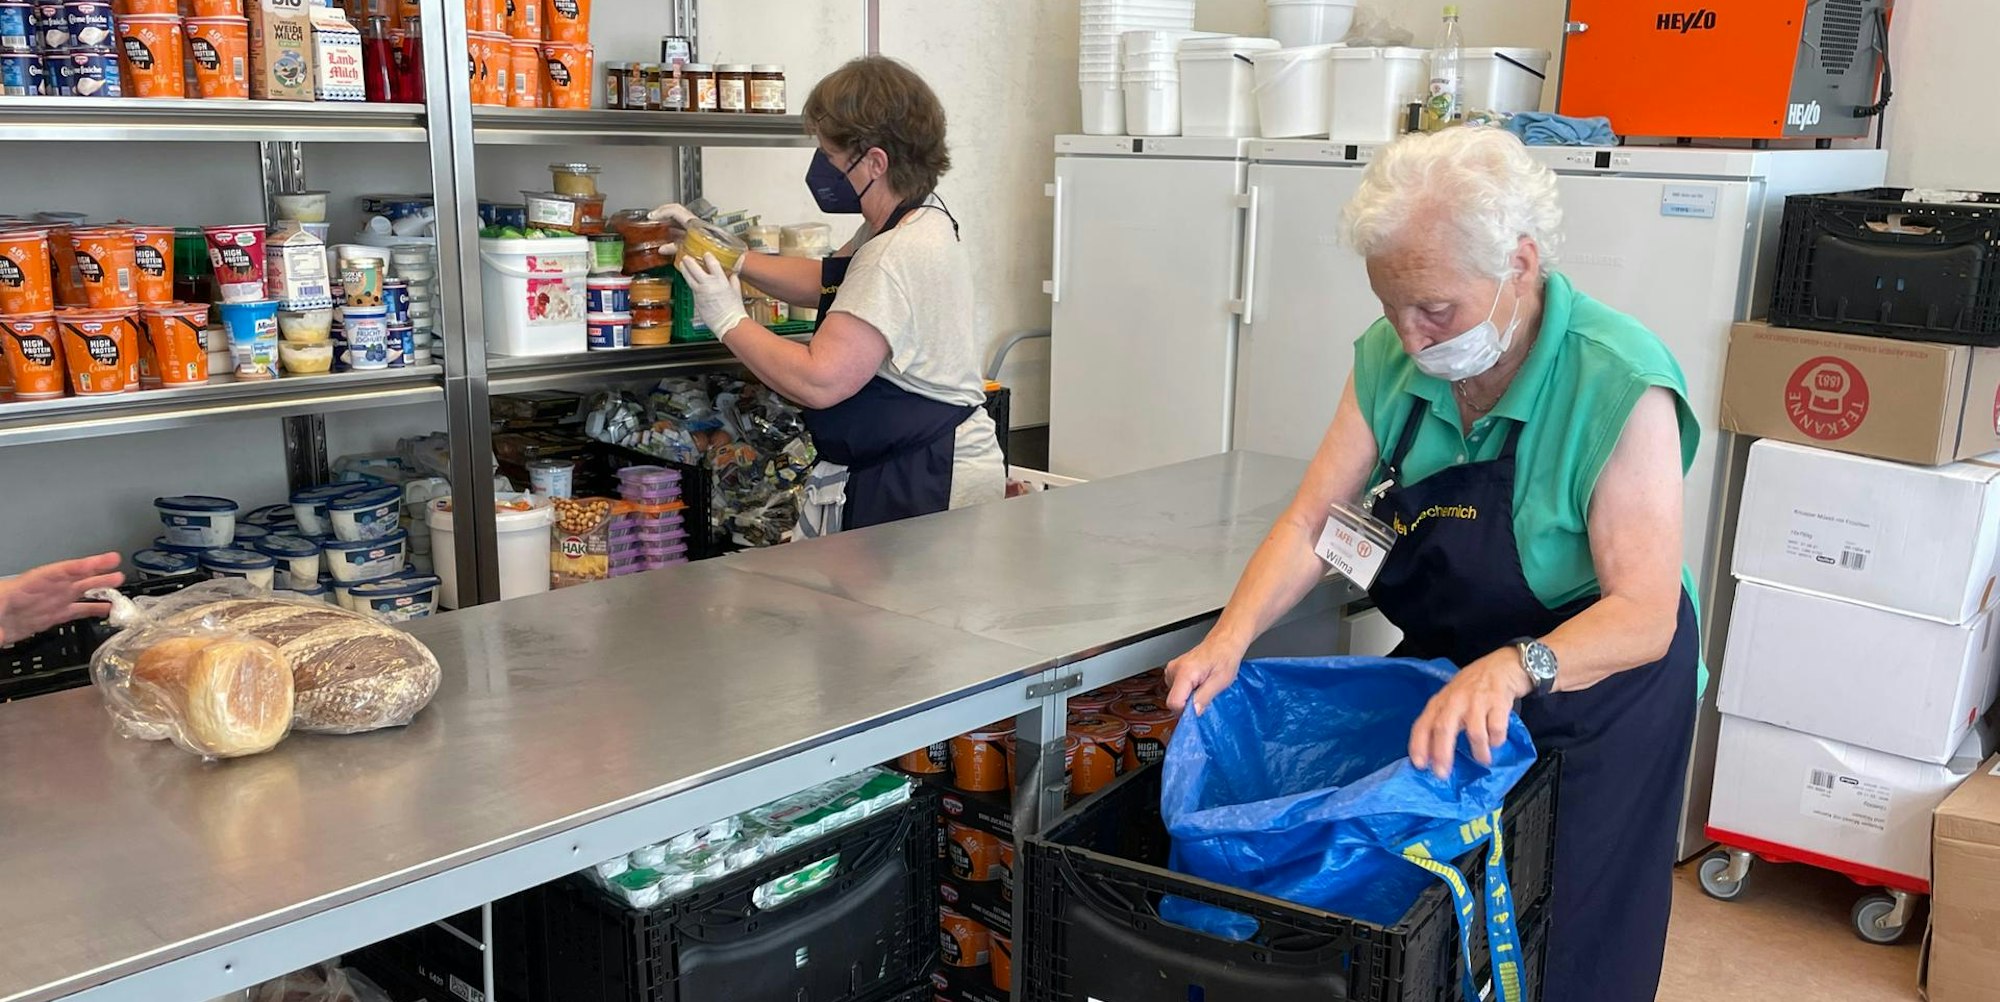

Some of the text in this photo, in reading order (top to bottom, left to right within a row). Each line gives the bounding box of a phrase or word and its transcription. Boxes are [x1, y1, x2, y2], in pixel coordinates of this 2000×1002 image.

[1656, 9, 1717, 34] HEYLO
[273, 24, 303, 34] WEIDE
[275, 31, 303, 41] MILCH
[329, 66, 359, 79] Milch
[1787, 100, 1821, 131] HEYLO
[136, 250, 155, 258] HIGH
[137, 257, 162, 265] PROTEIN
[225, 256, 250, 264] PROTEIN
[22, 340, 44, 348] HIGH
[90, 340, 111, 348] HIGH
[24, 347, 51, 355] PROTEIN
[91, 346, 117, 354] PROTEIN
[1818, 375, 1841, 388] 1881
[1789, 391, 1865, 435] TEEKANNE
[562, 542, 587, 554] HAK
[1326, 548, 1354, 575] Wilma
